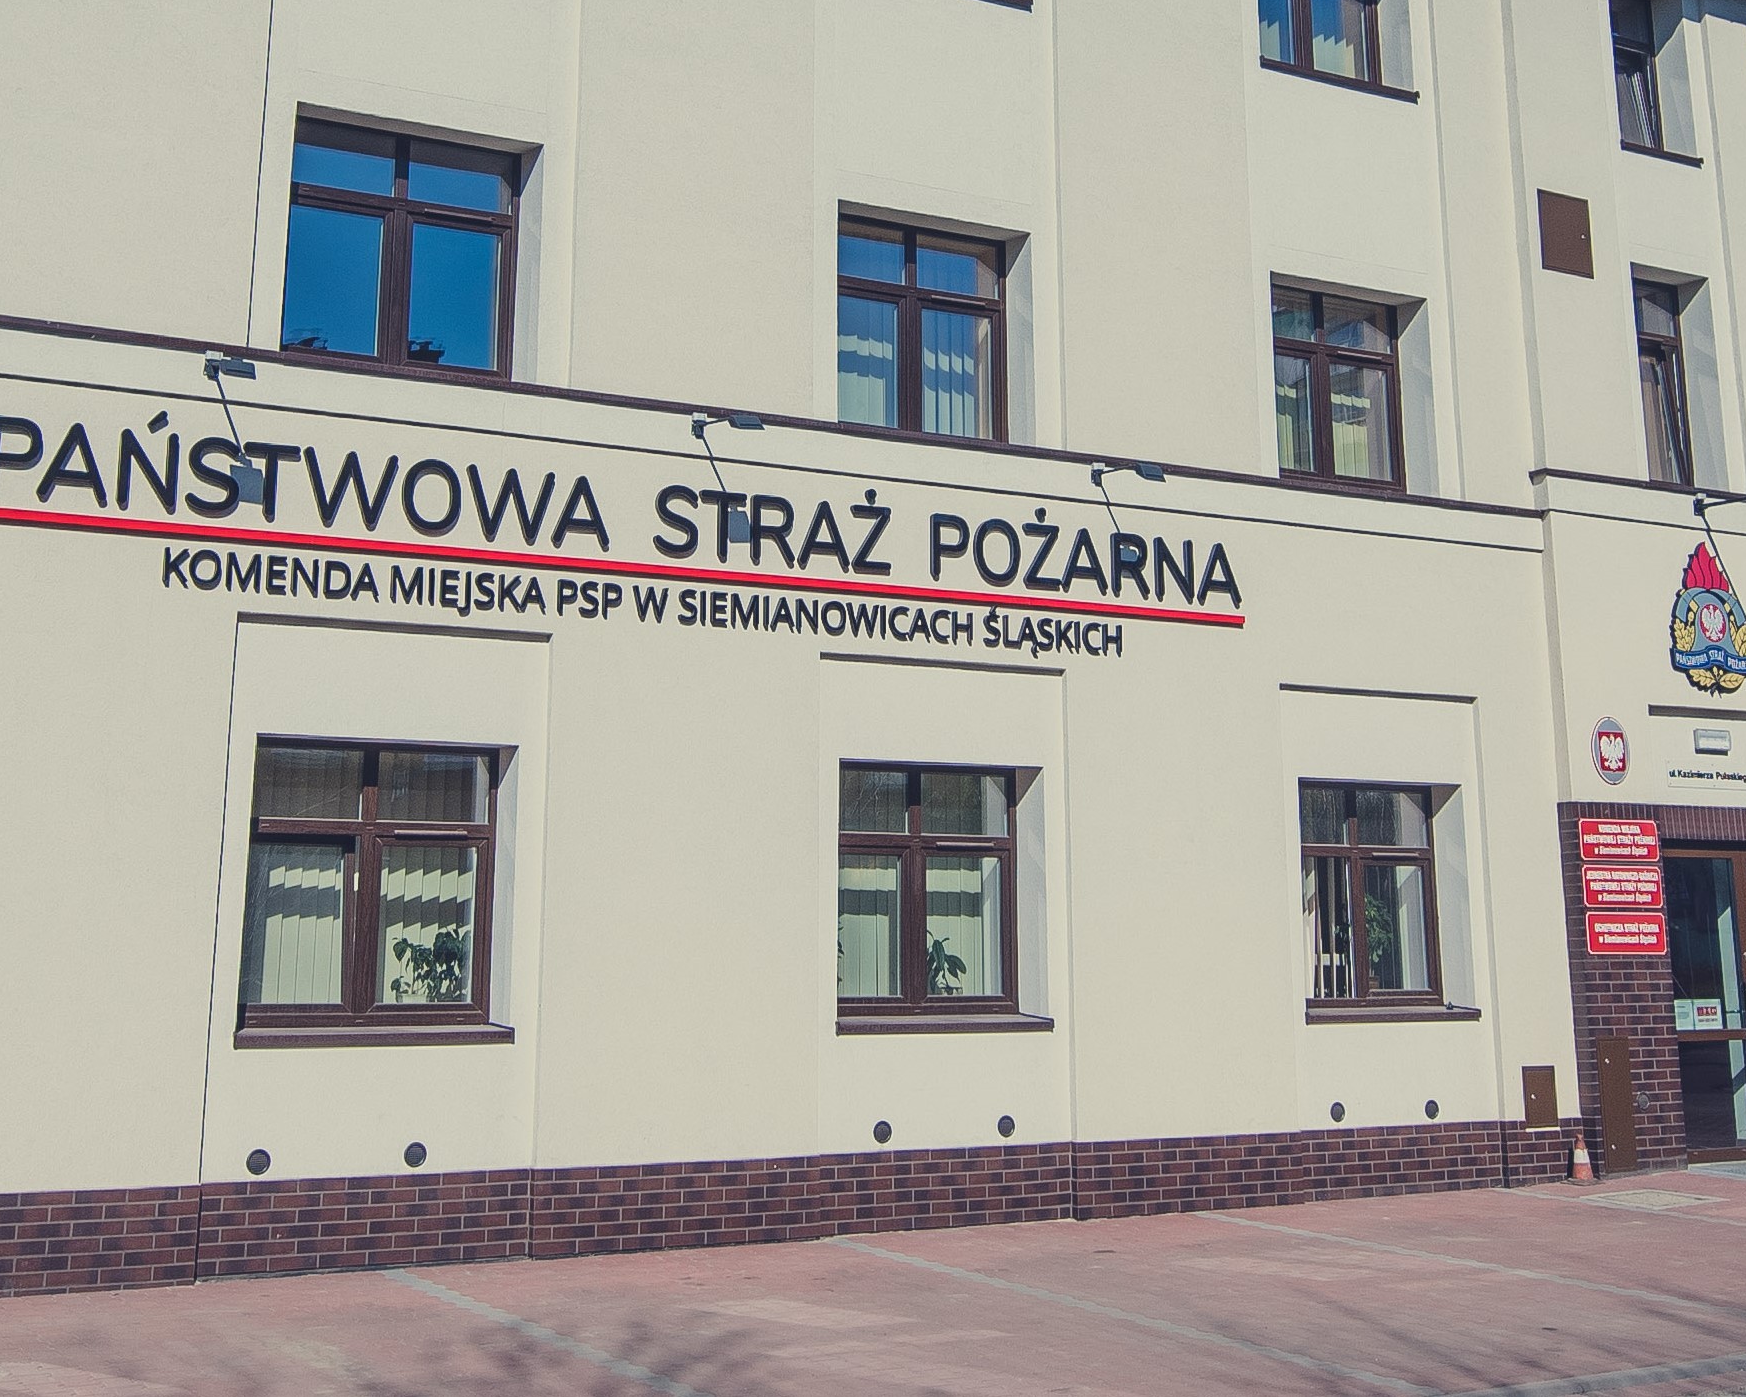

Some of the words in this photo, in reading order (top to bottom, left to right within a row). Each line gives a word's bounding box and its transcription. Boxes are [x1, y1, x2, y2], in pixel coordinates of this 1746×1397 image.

[162, 546, 379, 604] KOMENDA
[390, 564, 547, 617] MIEJSKA
[556, 578, 623, 620] PSP
[632, 585, 670, 624] W
[678, 589, 974, 644] SIEMIANOWICACH
[983, 606, 1123, 660] ŚLĄSKICH
[653, 488, 892, 577] STRAŻ
[929, 506, 1243, 609] POŻARNA
